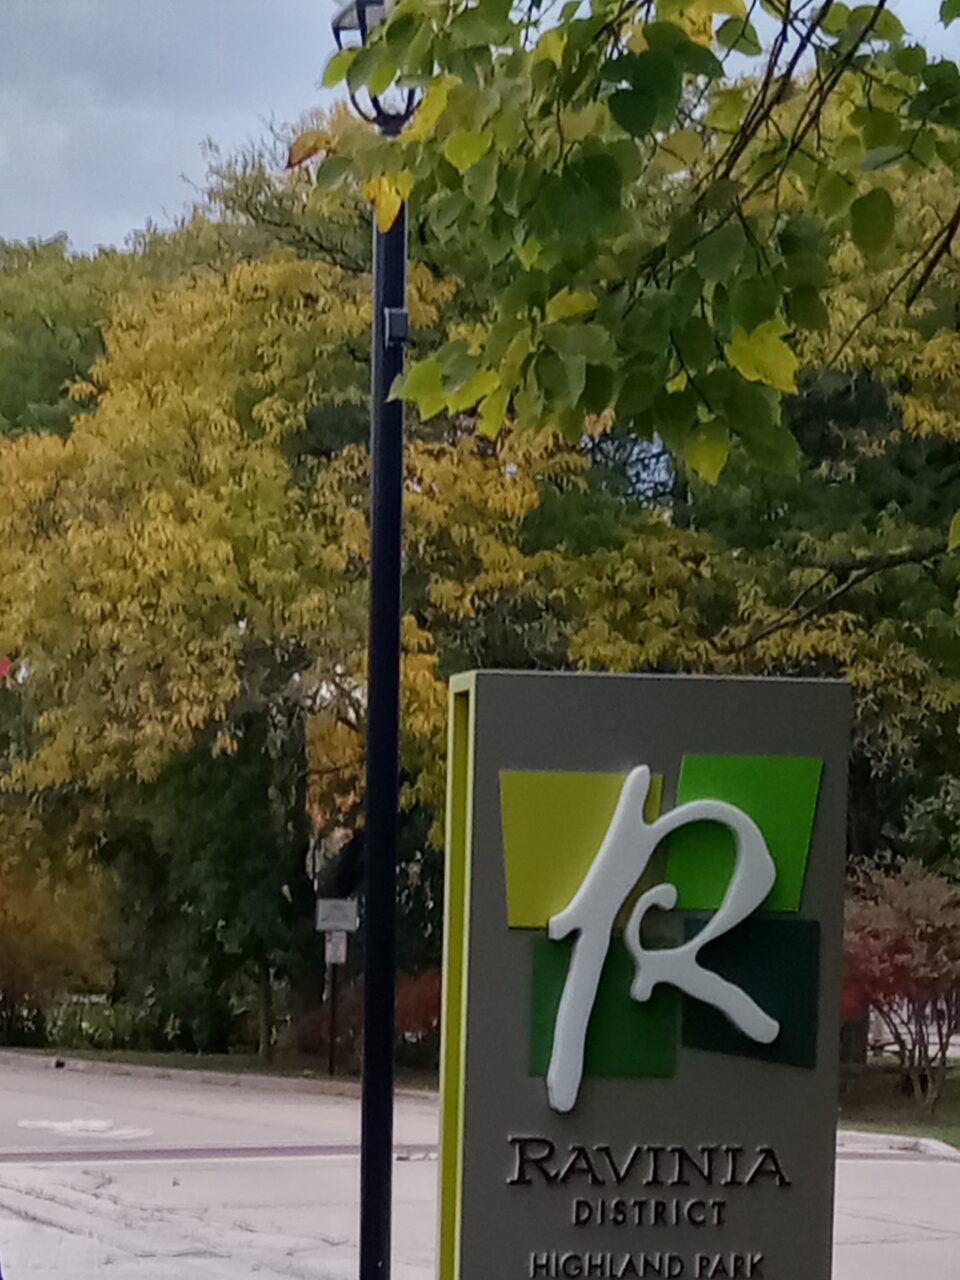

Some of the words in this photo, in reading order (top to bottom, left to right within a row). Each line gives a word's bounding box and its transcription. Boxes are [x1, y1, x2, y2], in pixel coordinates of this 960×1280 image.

[506, 1134, 791, 1187] RAVINIA
[571, 1198, 727, 1227] DISTRICT
[529, 1251, 685, 1279] HIGHLAND
[693, 1251, 765, 1279] PARK
